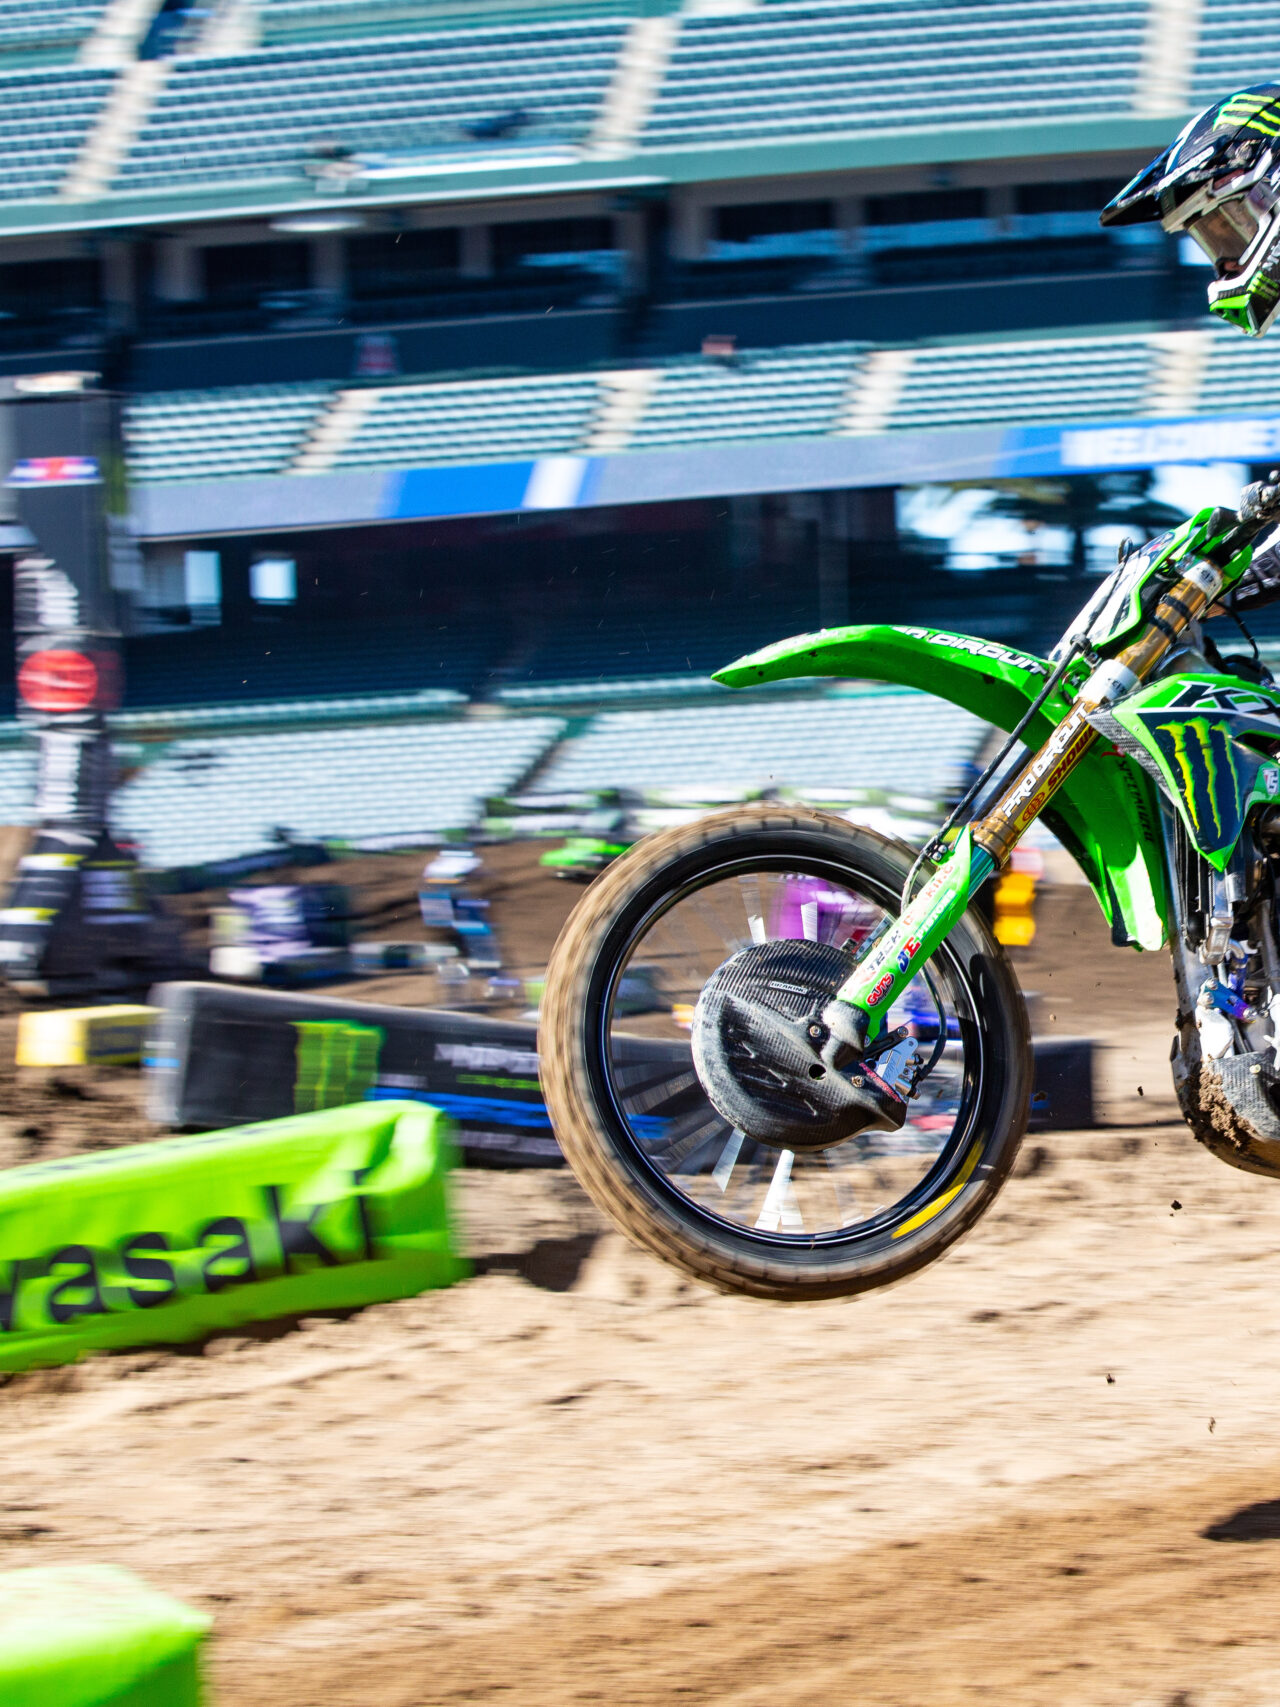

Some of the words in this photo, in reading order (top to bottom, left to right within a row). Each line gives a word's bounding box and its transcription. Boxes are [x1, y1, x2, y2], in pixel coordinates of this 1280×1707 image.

[926, 632, 1048, 676] CIRCUIT
[1001, 772, 1037, 818] PRO
[896, 936, 922, 974] JE
[867, 972, 893, 1005] GUTS
